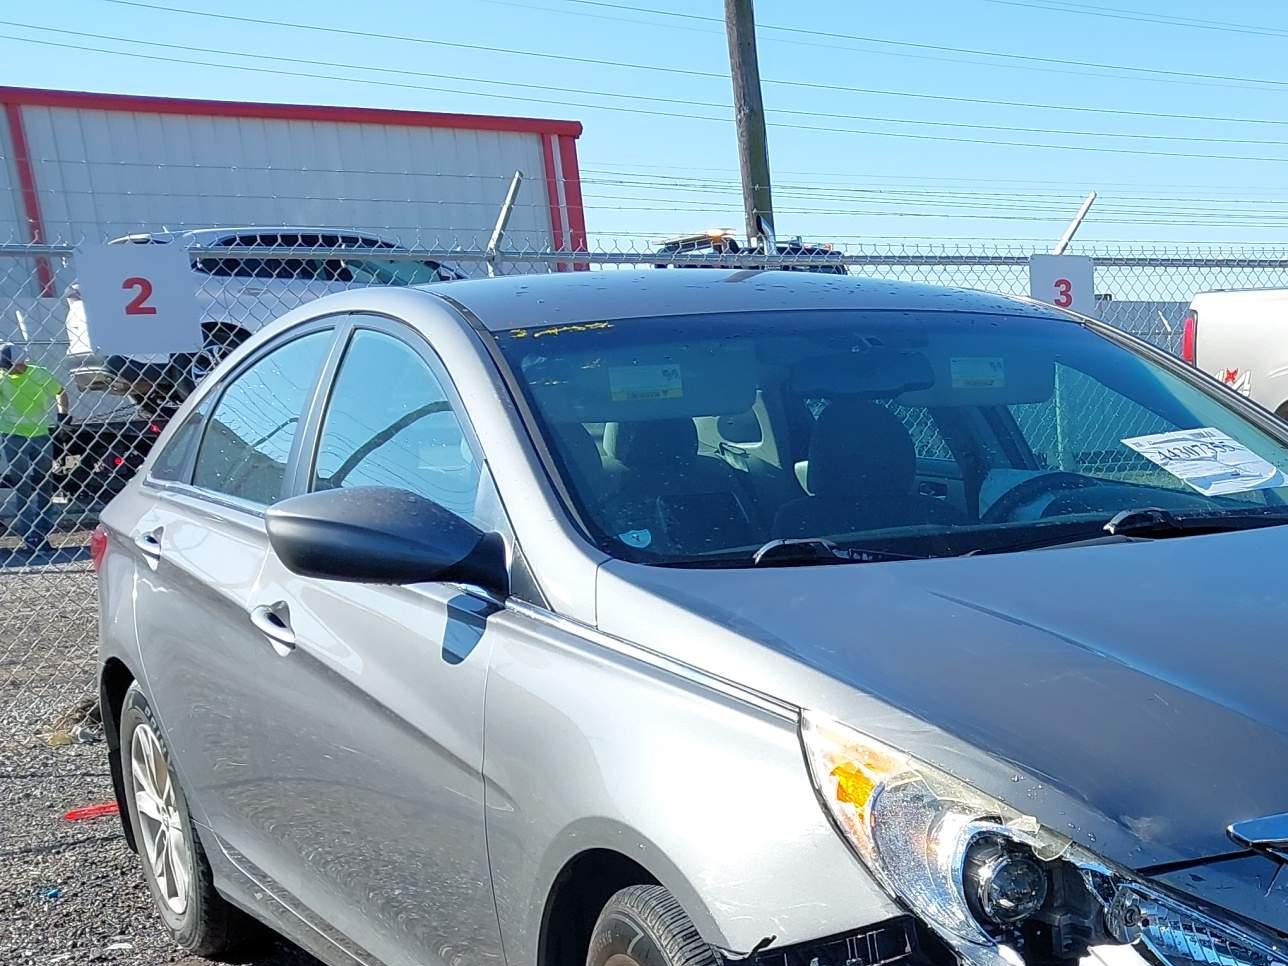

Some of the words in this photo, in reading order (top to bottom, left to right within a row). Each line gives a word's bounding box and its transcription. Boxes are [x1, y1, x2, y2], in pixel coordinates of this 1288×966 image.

[121, 276, 158, 315] 2
[1053, 278, 1074, 308] 3
[1157, 441, 1236, 461] 44307355
